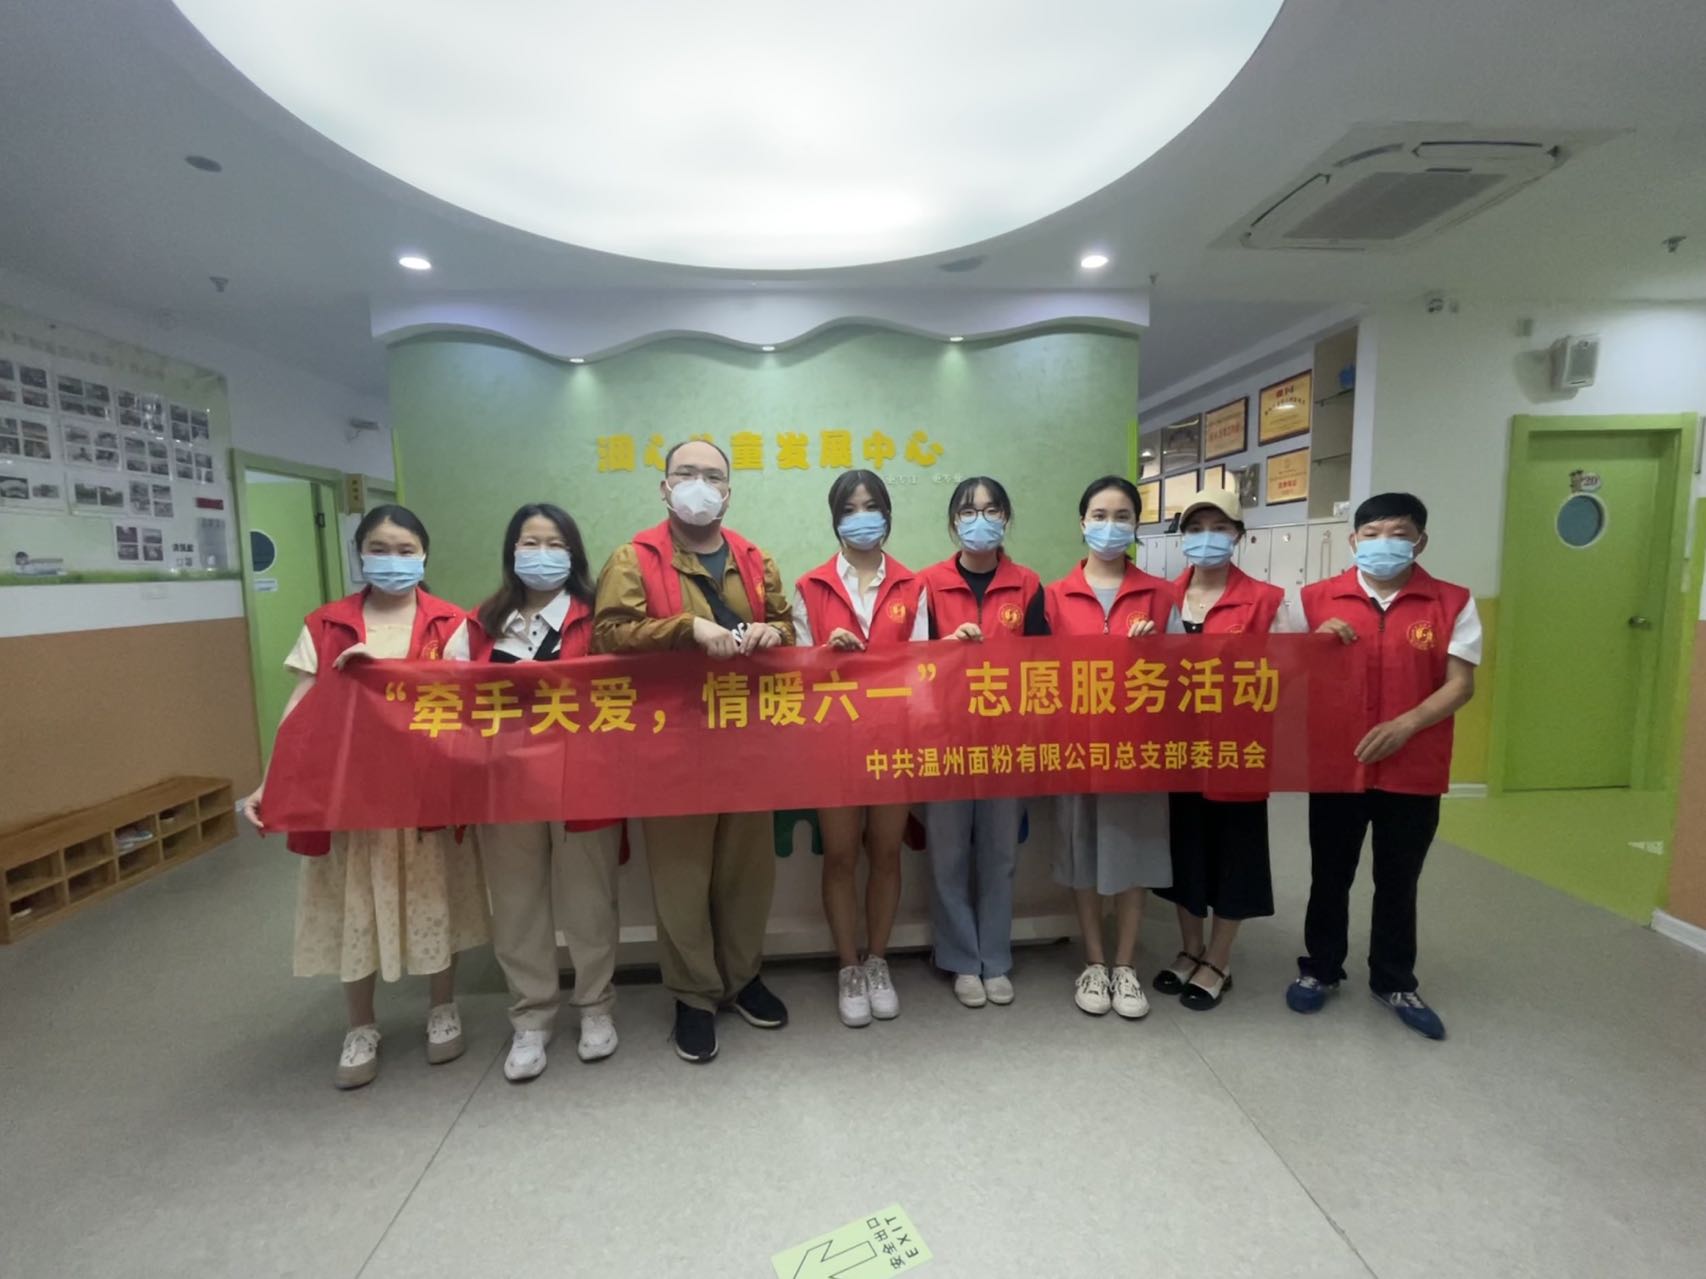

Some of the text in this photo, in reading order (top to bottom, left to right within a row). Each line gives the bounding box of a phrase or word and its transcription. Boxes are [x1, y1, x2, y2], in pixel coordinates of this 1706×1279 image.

[866, 741, 1266, 779] 中共温州面粉有限公司总支部委员会
[866, 1217, 906, 1269] 安全出口
[885, 1216, 919, 1258] EXIT
